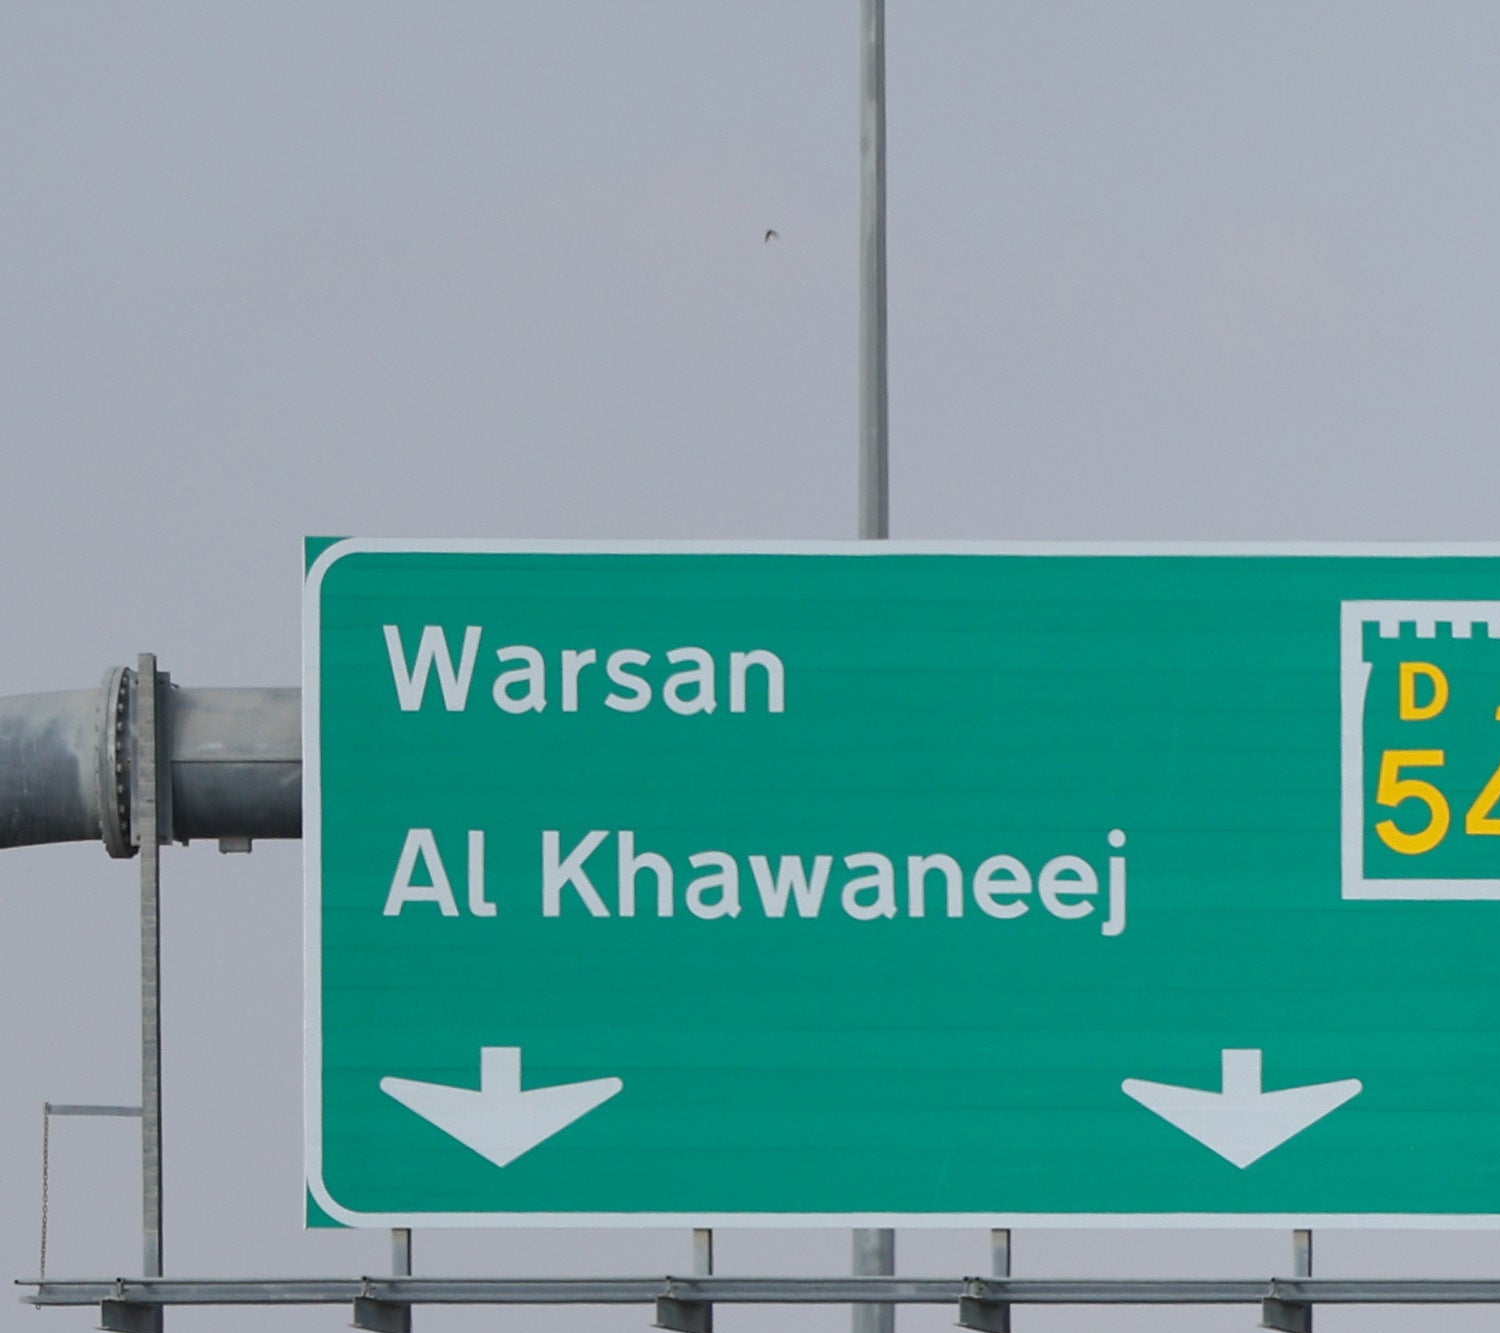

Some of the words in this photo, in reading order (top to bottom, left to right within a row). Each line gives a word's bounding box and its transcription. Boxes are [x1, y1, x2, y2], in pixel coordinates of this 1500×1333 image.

[383, 625, 784, 715] Warsan
[1400, 662, 1449, 720] D
[384, 829, 497, 916] Al
[543, 829, 1126, 936] Khawaneej
